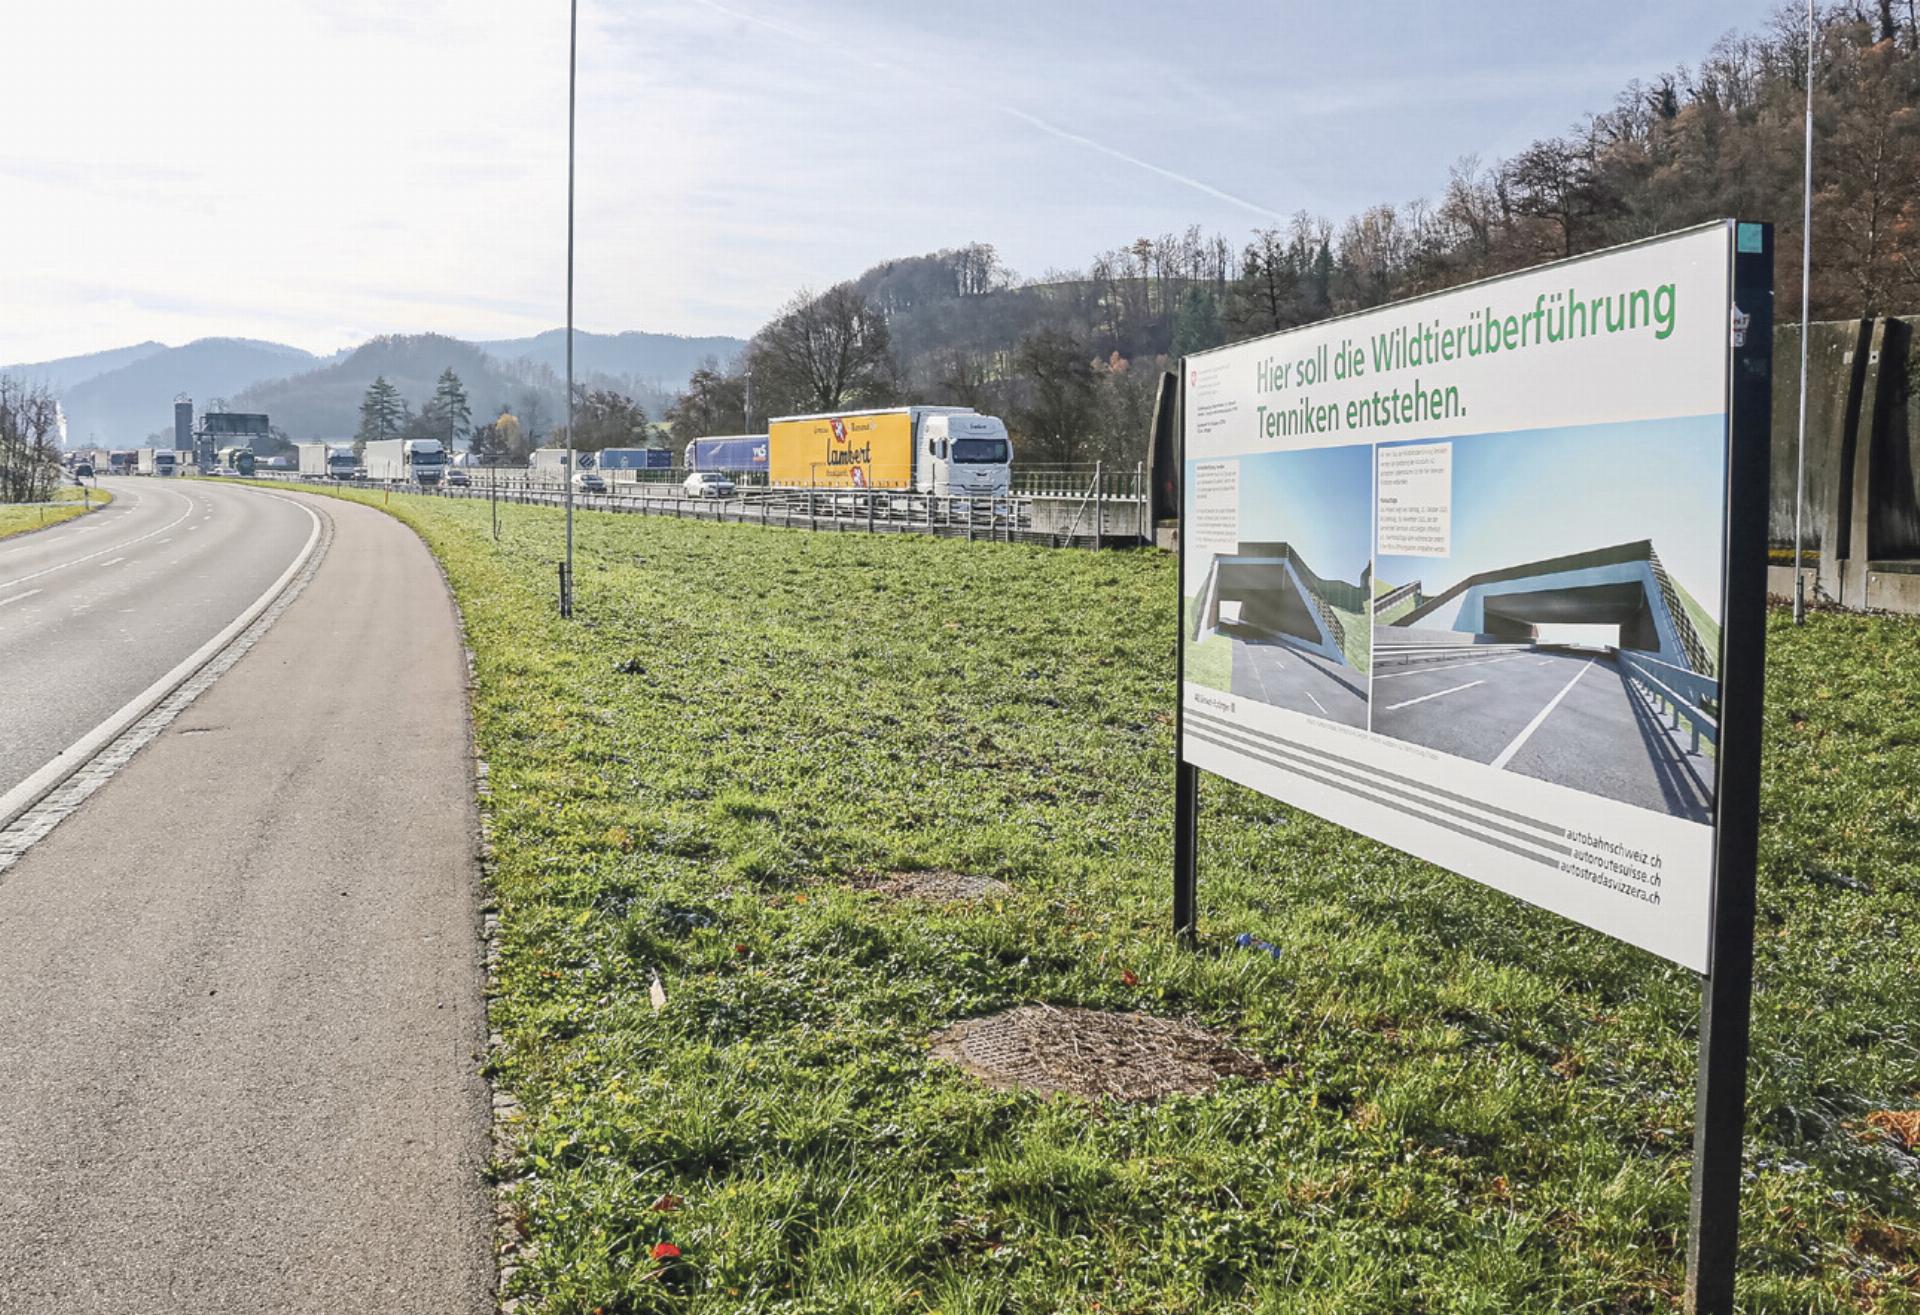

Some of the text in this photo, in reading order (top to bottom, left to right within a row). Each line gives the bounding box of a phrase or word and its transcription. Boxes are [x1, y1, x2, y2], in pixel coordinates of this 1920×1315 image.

[1257, 355, 1292, 394] Hier
[1297, 343, 1328, 388] soll
[1334, 340, 1365, 380] die
[1371, 283, 1677, 372] Wildtierüberführung
[1257, 379, 1467, 439] Tenniken entstehen.
[1566, 829, 1662, 869] autobahnschweiz.ch
[1573, 849, 1661, 887] autoroutesuisse.ch
[1560, 862, 1661, 905] autostradasvizzera.ch
